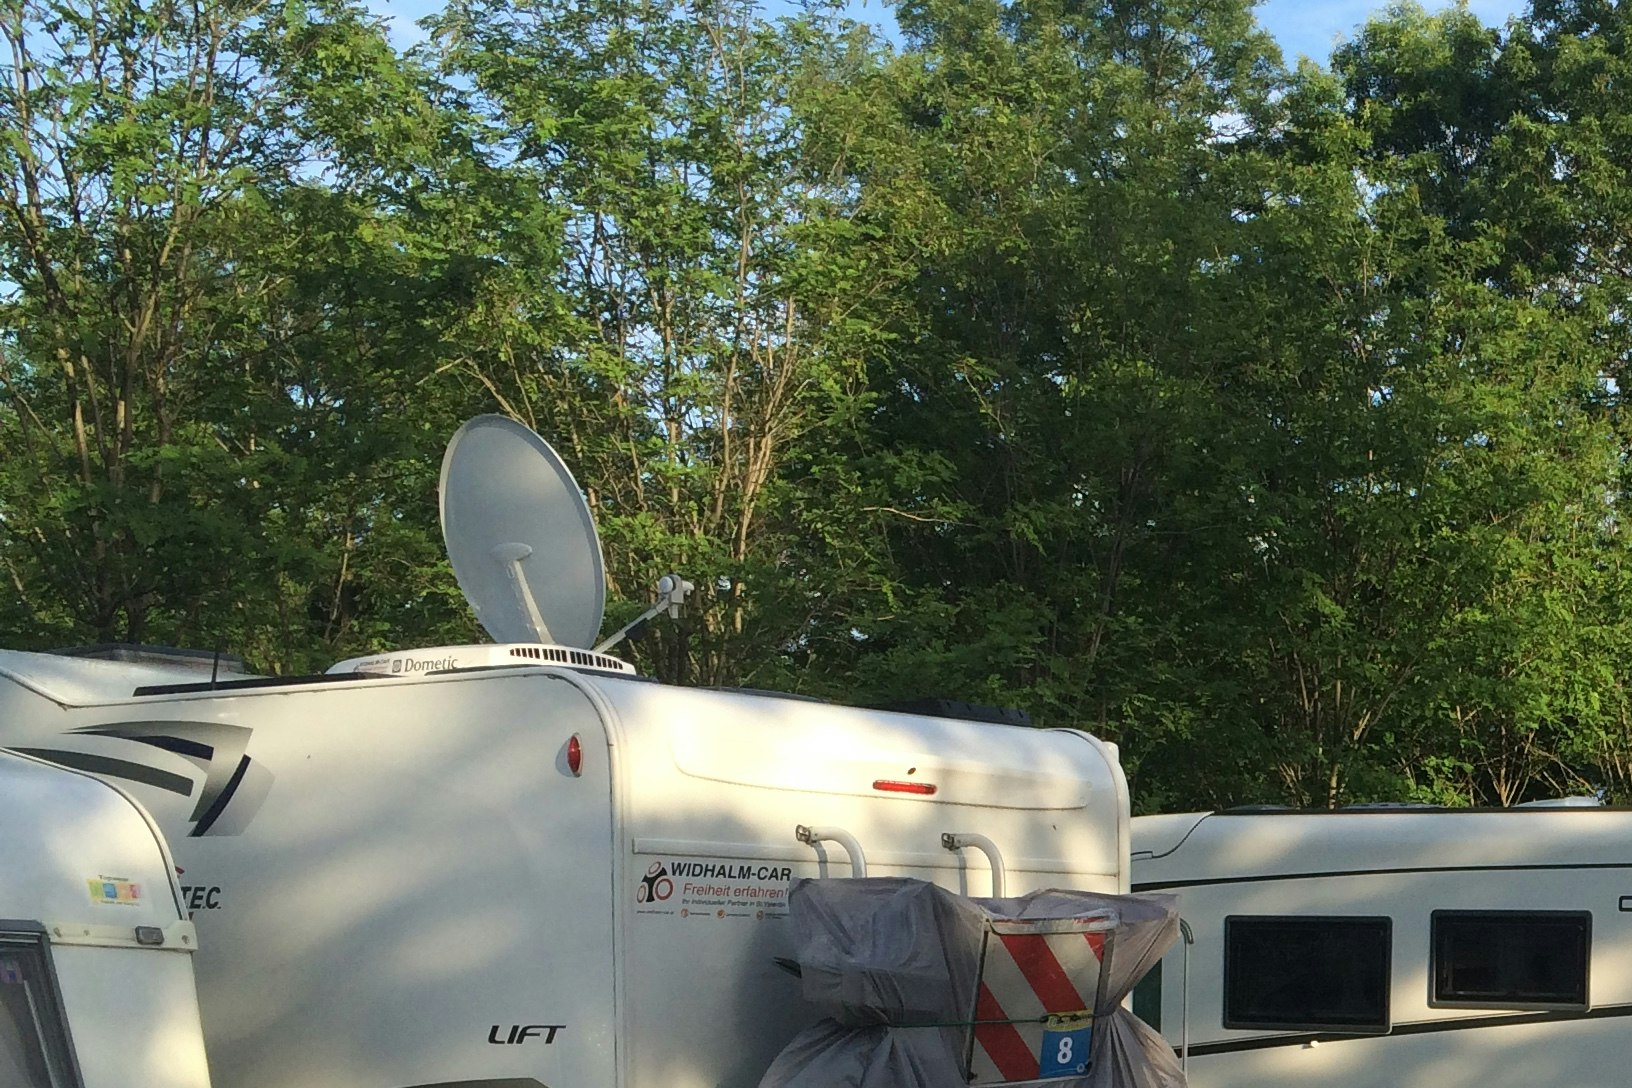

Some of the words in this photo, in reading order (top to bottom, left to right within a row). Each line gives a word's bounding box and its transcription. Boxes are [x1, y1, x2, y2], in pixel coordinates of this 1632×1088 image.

[404, 655, 458, 673] Dometic
[671, 862, 792, 882] WIDHALM-CAR
[682, 882, 731, 897] Freiheit
[733, 884, 789, 899] erfahren!
[487, 1024, 567, 1045] LIFT
[1056, 1036, 1073, 1065] 8
